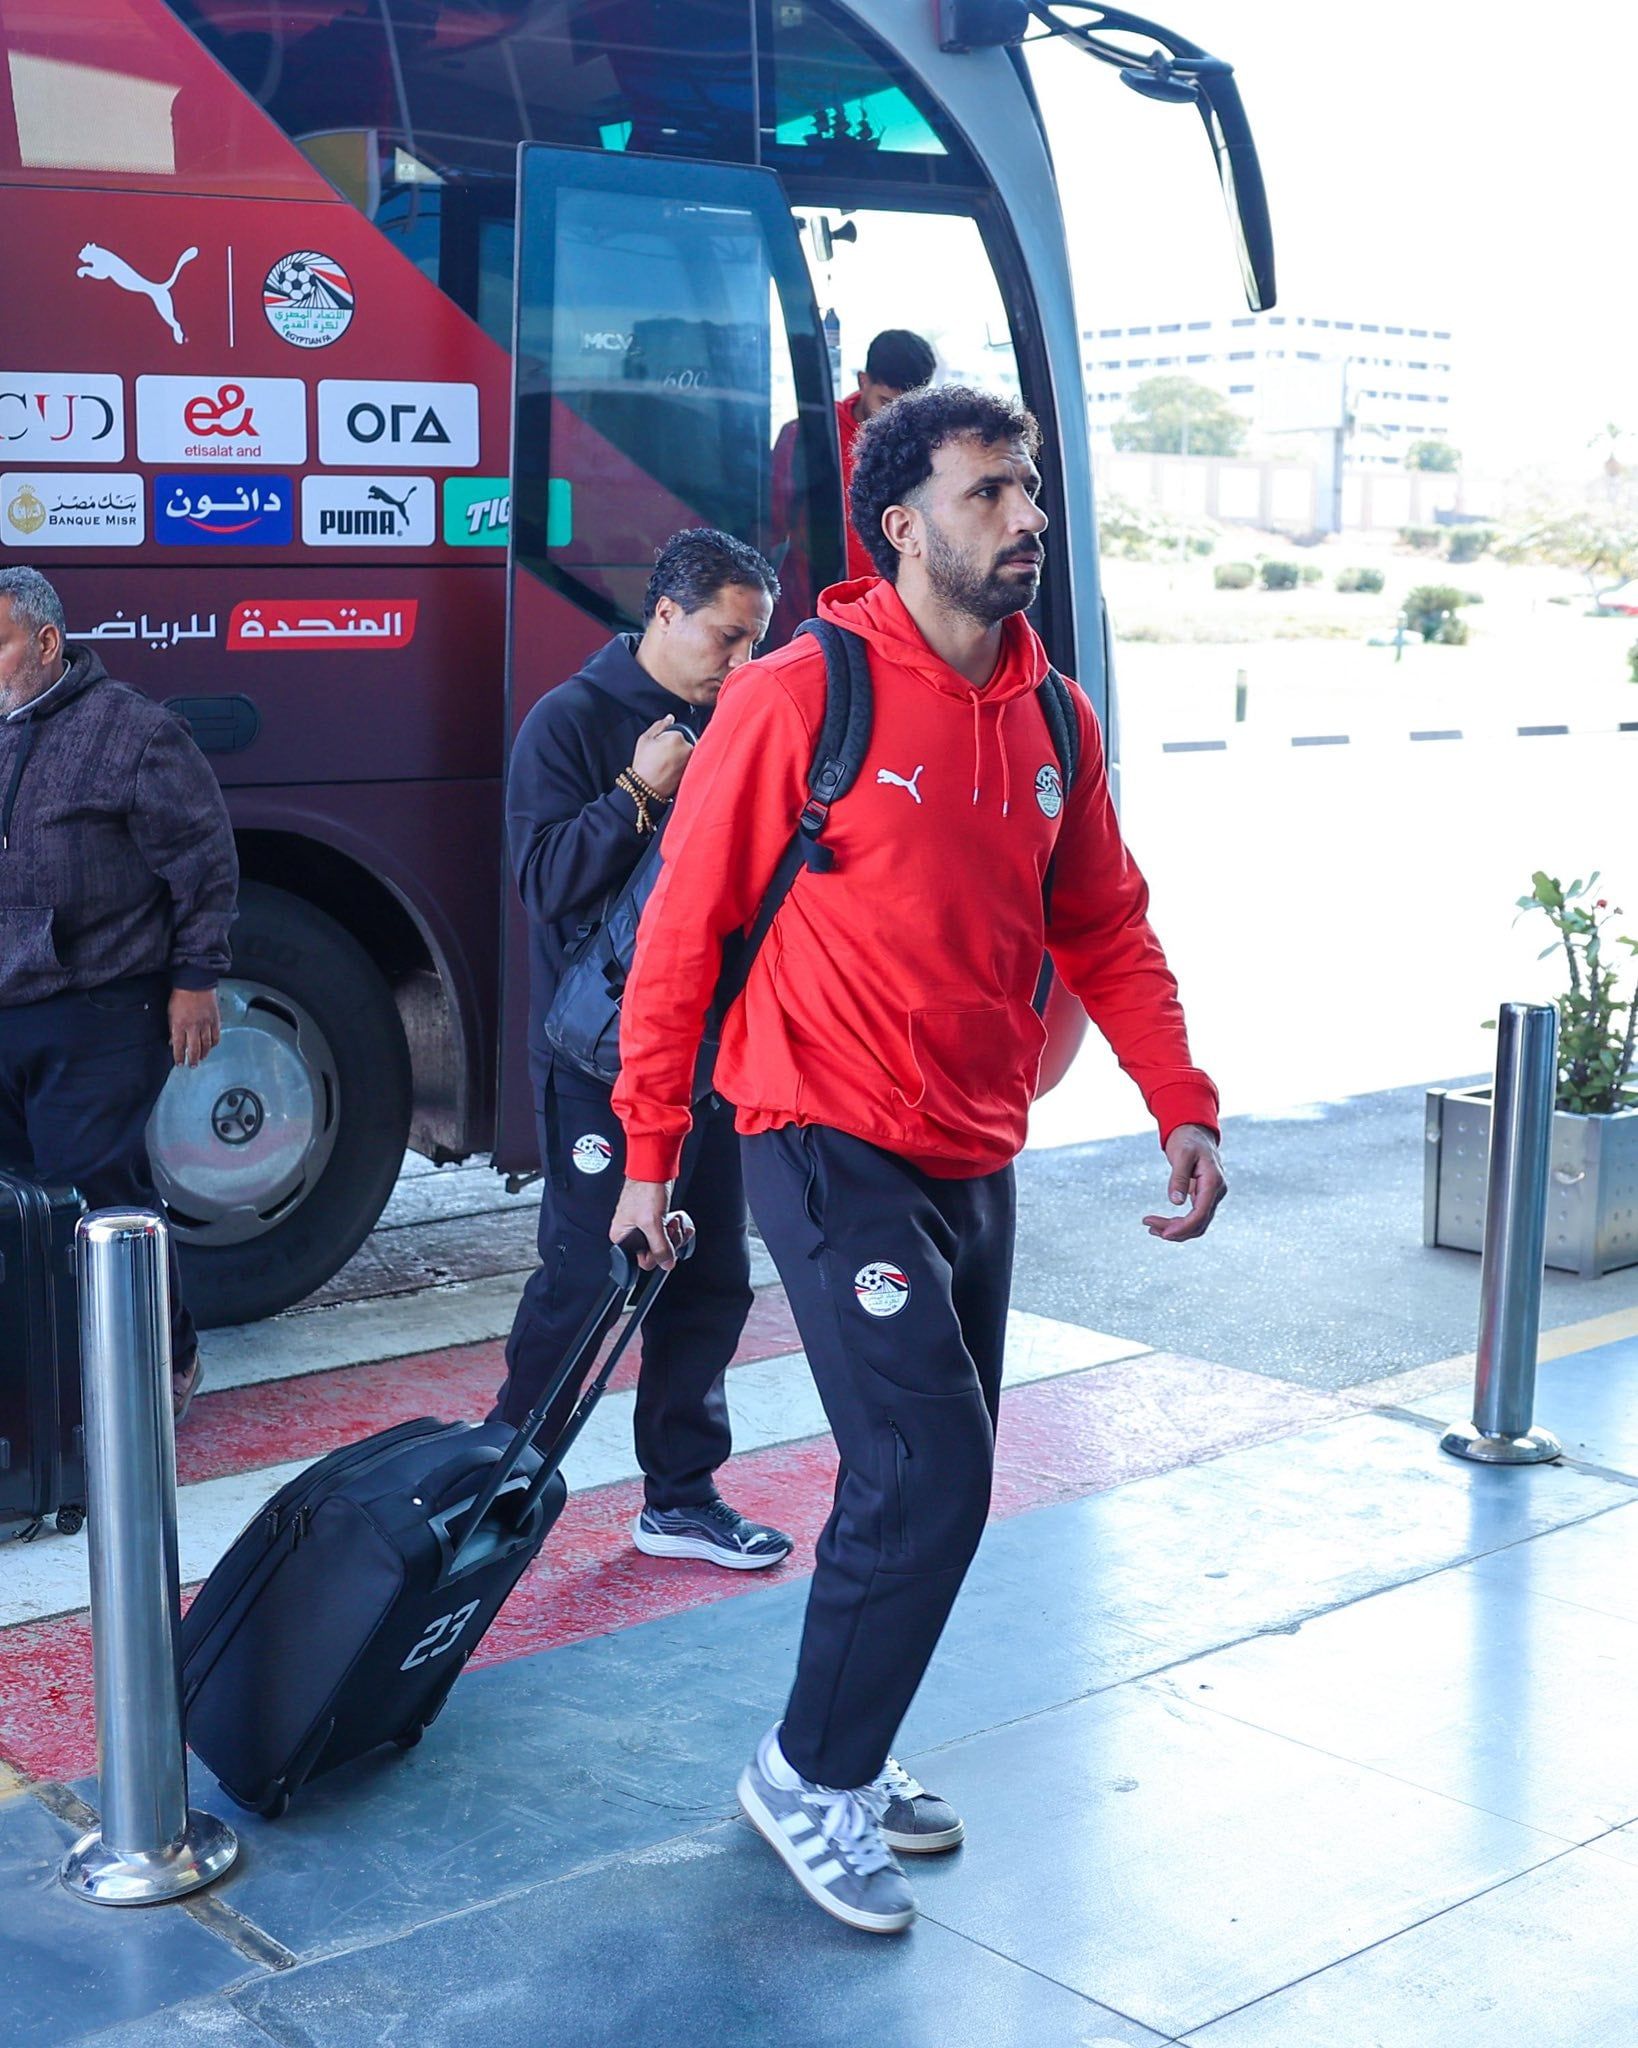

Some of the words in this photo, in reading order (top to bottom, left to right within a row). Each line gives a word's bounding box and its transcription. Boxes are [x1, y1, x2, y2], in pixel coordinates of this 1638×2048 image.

[285, 330, 322, 345] EGYPTIAN
[322, 334, 333, 342] FA
[0, 392, 114, 441] CUD
[185, 444, 233, 457] etisalat
[236, 445, 262, 457] and
[166, 487, 281, 519] دانون
[49, 515, 101, 526] BANQUE
[320, 510, 395, 535] PUMA
[65, 611, 216, 649] للرياض
[240, 608, 401, 638] المتحدة
[400, 1599, 481, 1671] 23
